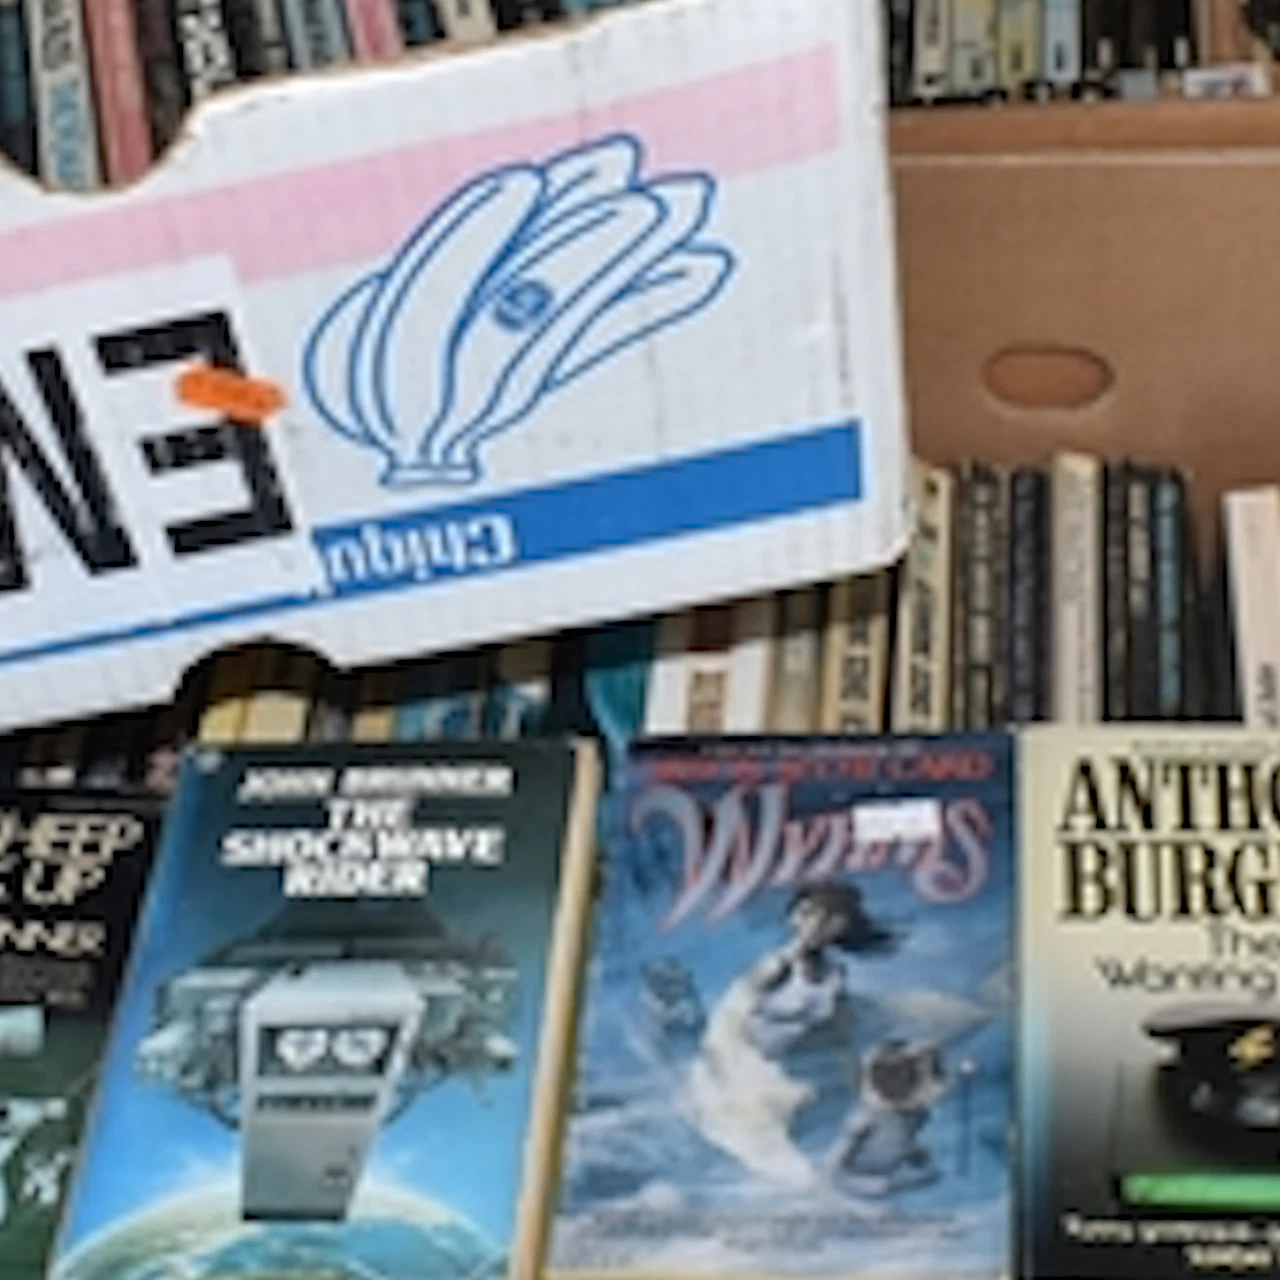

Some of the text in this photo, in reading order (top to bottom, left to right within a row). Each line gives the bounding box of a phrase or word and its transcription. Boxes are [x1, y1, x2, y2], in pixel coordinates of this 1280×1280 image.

[327, 513, 516, 583] Chiqu
[235, 764, 514, 805] JOHN BRUNNER
[326, 797, 416, 831] THE
[219, 827, 507, 868] SHOCKWAVE
[21, 858, 108, 906] UP
[281, 859, 430, 898] RIDER
[1093, 955, 1279, 1000] Wanting
